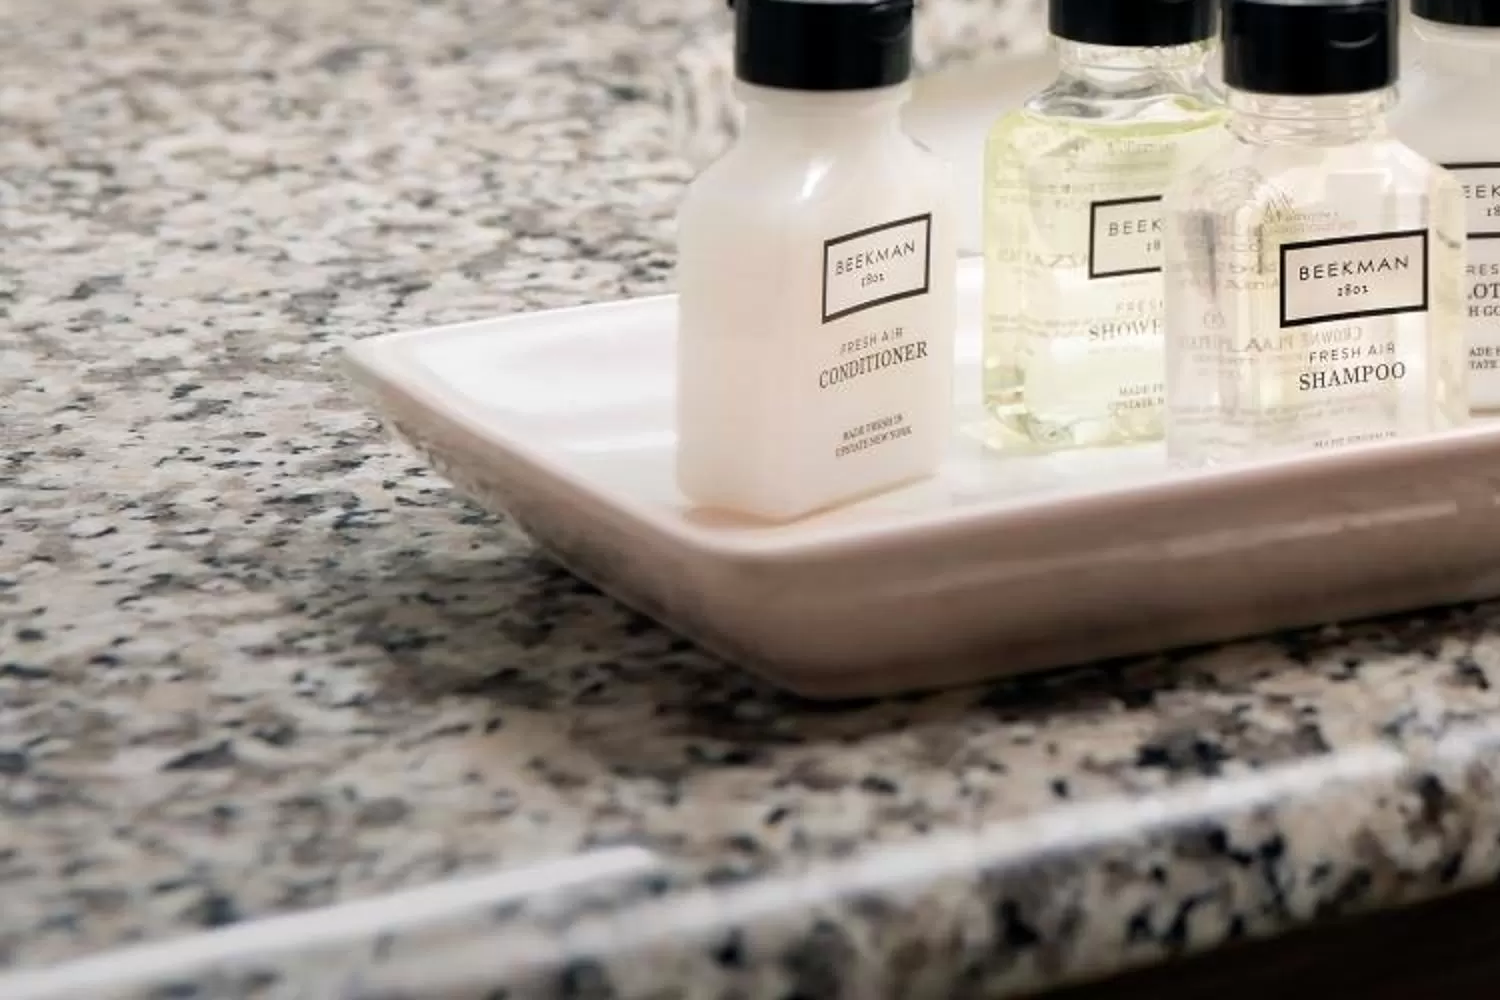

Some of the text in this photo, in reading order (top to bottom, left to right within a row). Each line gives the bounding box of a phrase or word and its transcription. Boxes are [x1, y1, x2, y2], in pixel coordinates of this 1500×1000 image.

[1108, 219, 1163, 237] BEEK
[835, 239, 916, 277] BEEKMAN
[1299, 255, 1409, 281] BEEKMAN
[841, 327, 903, 354] FRESH AIR
[1088, 319, 1163, 342] SHOWE
[1309, 346, 1361, 364] FRESH
[1367, 341, 1395, 357] AIR
[1469, 346, 1493, 358] ADE
[819, 340, 928, 389] CONDITIONER
[1299, 361, 1405, 391] SHAMPOO
[1469, 359, 1498, 370] TATE
